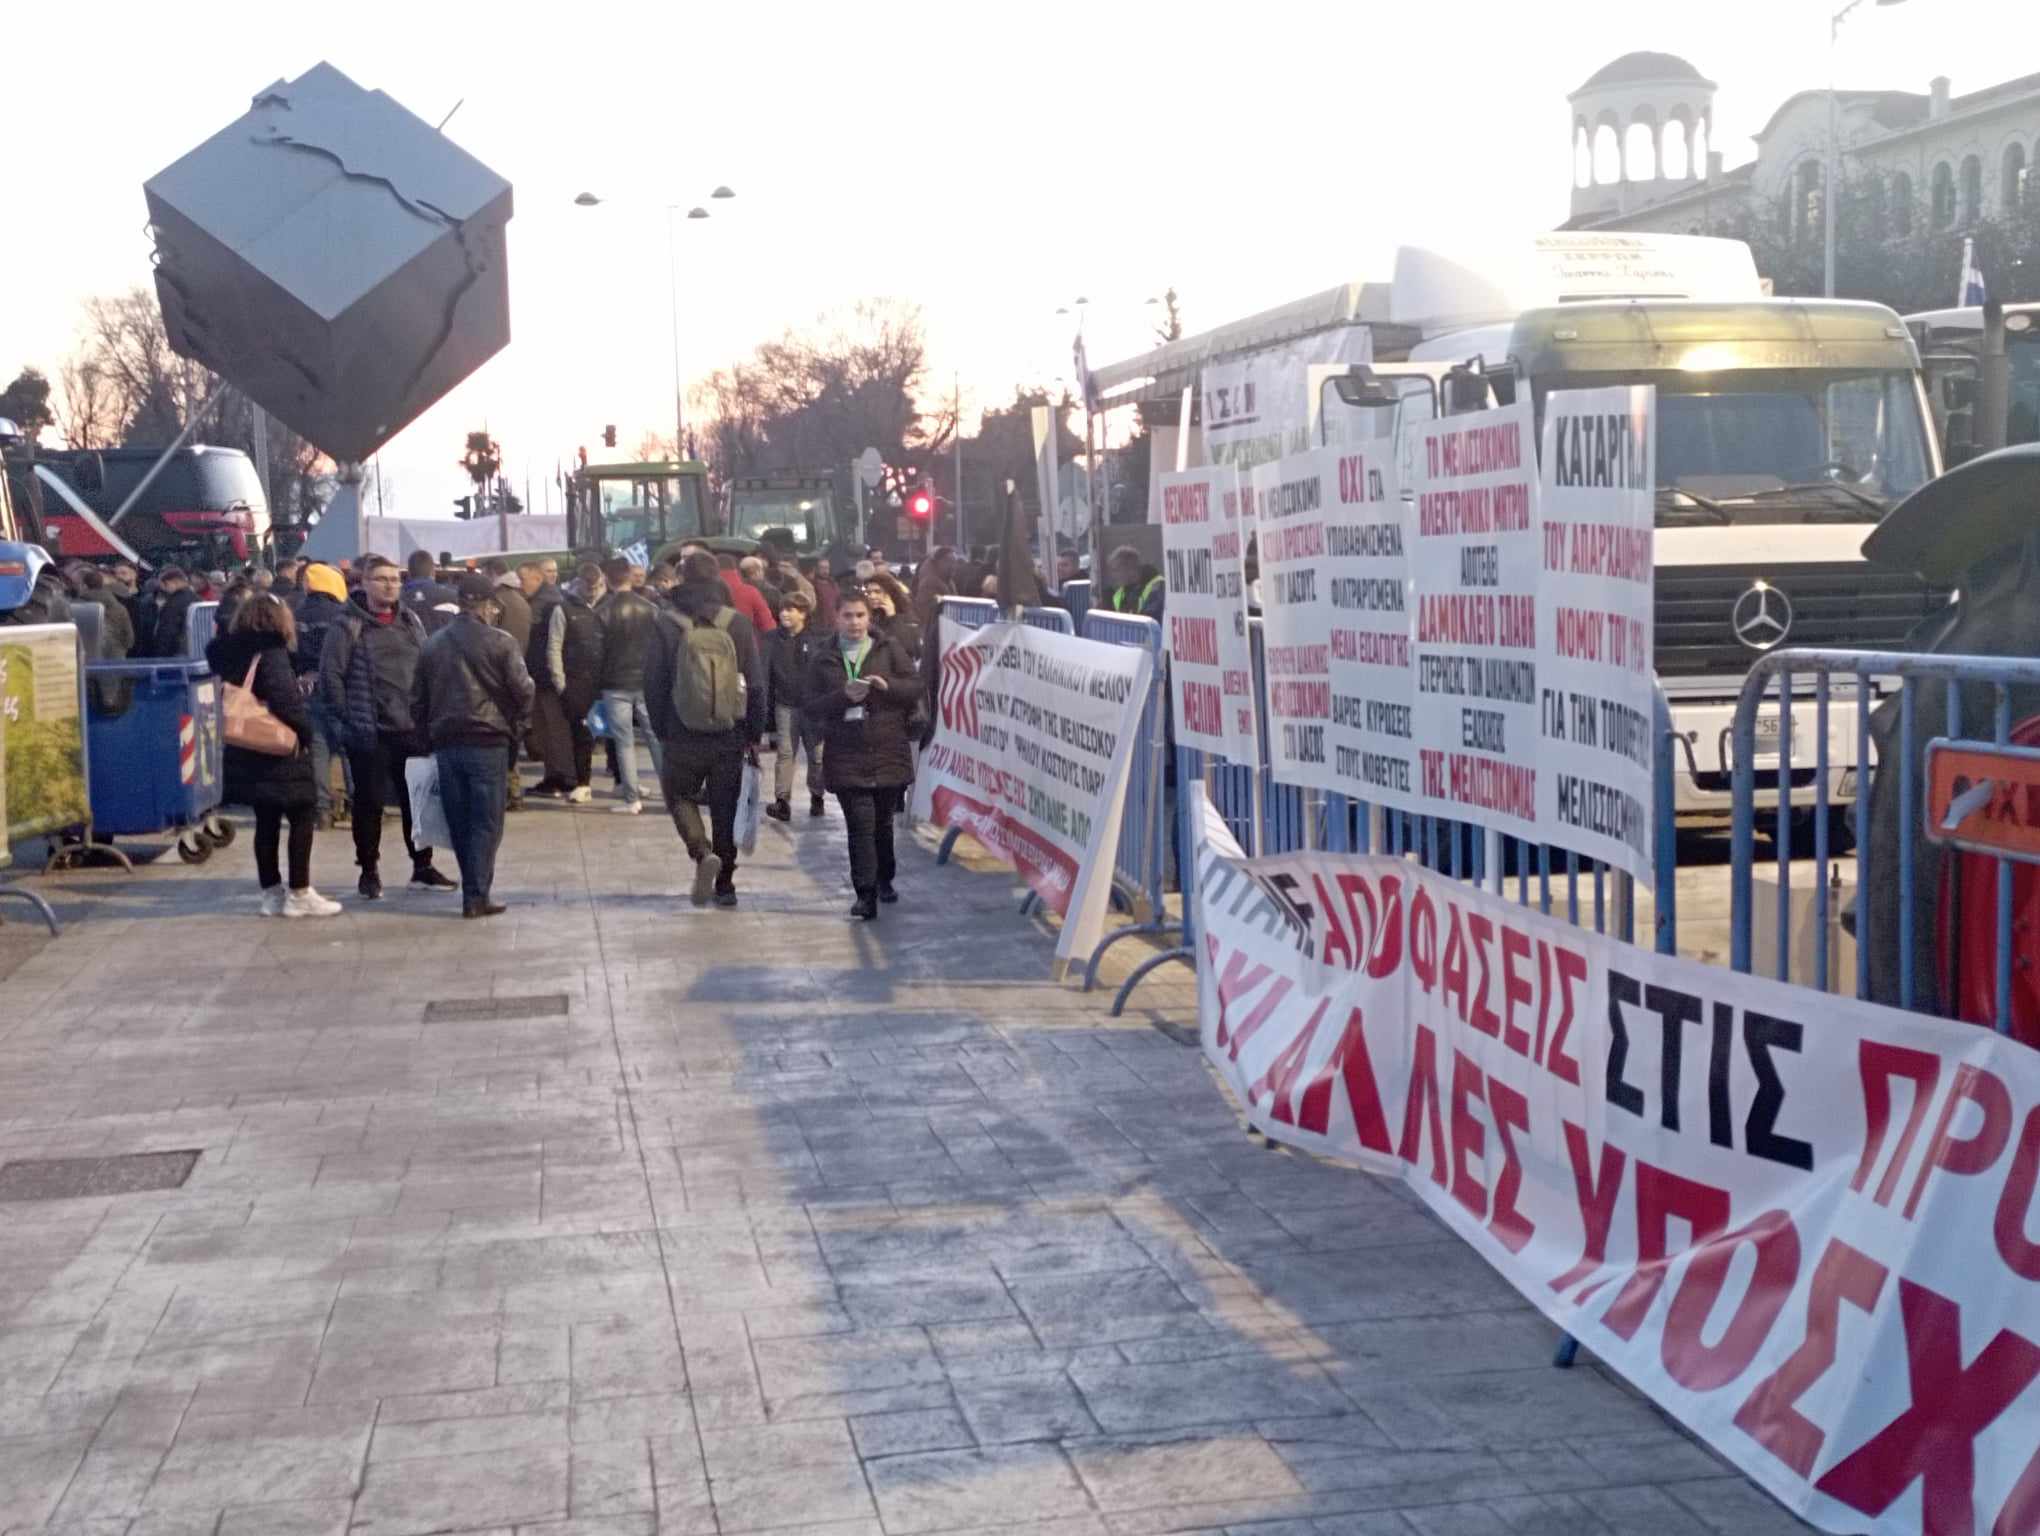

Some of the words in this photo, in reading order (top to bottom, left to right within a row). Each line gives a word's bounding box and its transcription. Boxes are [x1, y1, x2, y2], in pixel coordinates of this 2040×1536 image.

[1338, 455, 1364, 503] ΟΧΙ
[1326, 523, 1404, 557] ΥΠΟΒΑΘΜΙΣΜΕΝΑ
[1543, 520, 1566, 571] ΤΟΥ
[1418, 594, 1495, 645] ΔΑΜΟΚΛΕΙΟ
[1556, 607, 1604, 662] ΝΟΜΟΥ
[1332, 694, 1362, 729] ΒΑΡΙΕΣ
[1366, 699, 1412, 738] ΚΥΡΩΣΕΙΣ
[1543, 688, 1566, 740] ΓΙΑ
[1570, 692, 1597, 746] ΤΗΝ
[1336, 745, 1361, 780] ΣΤΟΥΣ
[1419, 748, 1446, 799] ΤΗΣ
[1449, 752, 1536, 822] ΜΕΛΙΣΣΟΚΟΜΙΑΣ
[1311, 871, 1588, 1086] ΑΠΟΦΑΣΕΙΣ
[1607, 968, 1815, 1172] ΣΤΙΣ
[1247, 996, 1537, 1255] ΑΛΛΕΣ
[1548, 1118, 2040, 1536] ΥΠΟΣΧ
